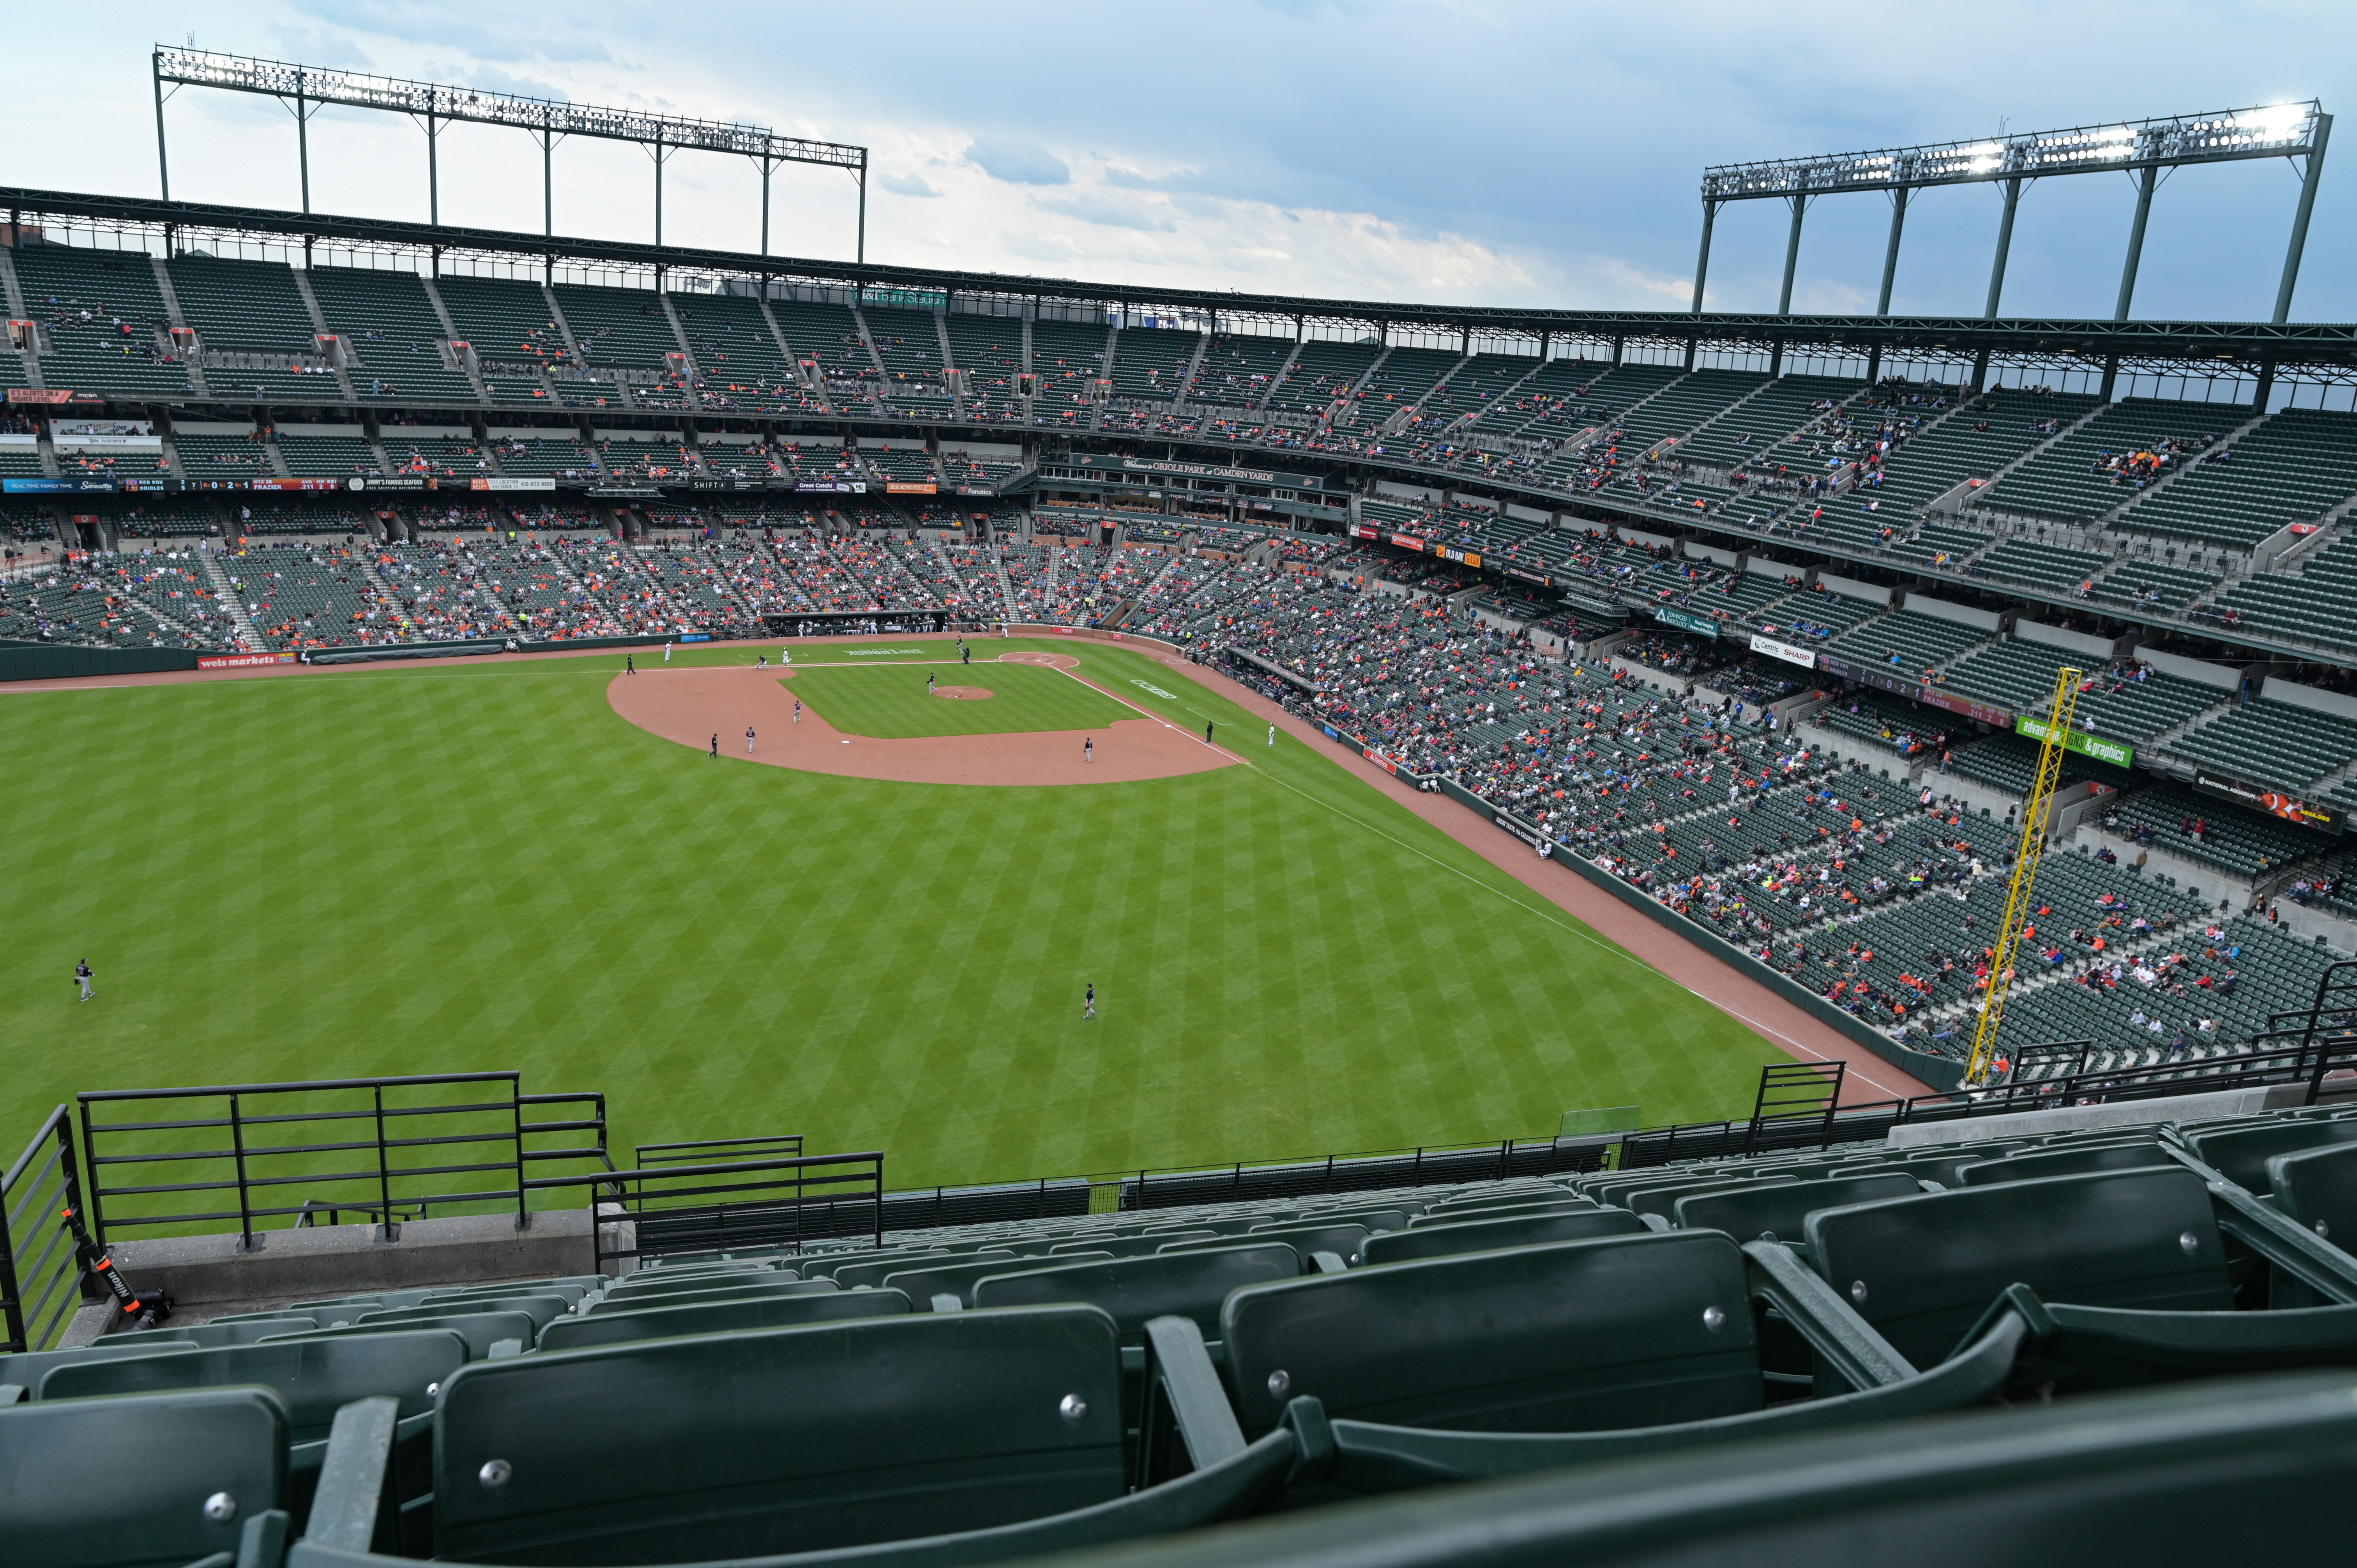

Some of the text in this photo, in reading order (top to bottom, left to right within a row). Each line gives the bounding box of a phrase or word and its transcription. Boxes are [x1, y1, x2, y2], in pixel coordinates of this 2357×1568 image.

[882, 290, 906, 302] Bank
[1124, 459, 1147, 469] Welcome
[1153, 462, 1184, 472] ORIOLE
[1184, 464, 1205, 474] PARK
[1213, 468, 1248, 479] CAMDEN
[1249, 471, 1273, 481] YARDS
[81, 481, 112, 490] Sarasota
[1446, 549, 1454, 559] OLD
[1466, 554, 1479, 566] SEASON
[1666, 616, 1687, 628] RADIOLOGY
[1667, 611, 1687, 622] ADVANCED
[1762, 642, 1779, 652] Centric
[1784, 649, 1810, 661] SHARP
[201, 656, 274, 667] weis markets
[1829, 667, 1848, 676] ORIOLES
[1130, 680, 1177, 698] GEICO
[1887, 680, 1892, 689] 0
[1900, 684, 1906, 693] 2
[1915, 688, 1919, 697] 1
[1924, 695, 1950, 708] FRAZIER
[1968, 709, 1982, 719] .211
[2085, 738, 2092, 752] &
[2092, 742, 2125, 762] graphics
[2205, 779, 2255, 799] NATIONAL AQUARIUM
[2300, 809, 2330, 822] AQUA.ORG
[1496, 817, 1506, 826] GREAT
[1506, 822, 1516, 833] TASTE.
[1520, 831, 1536, 846] CALORIES.
[108, 1271, 130, 1298] Nikon
